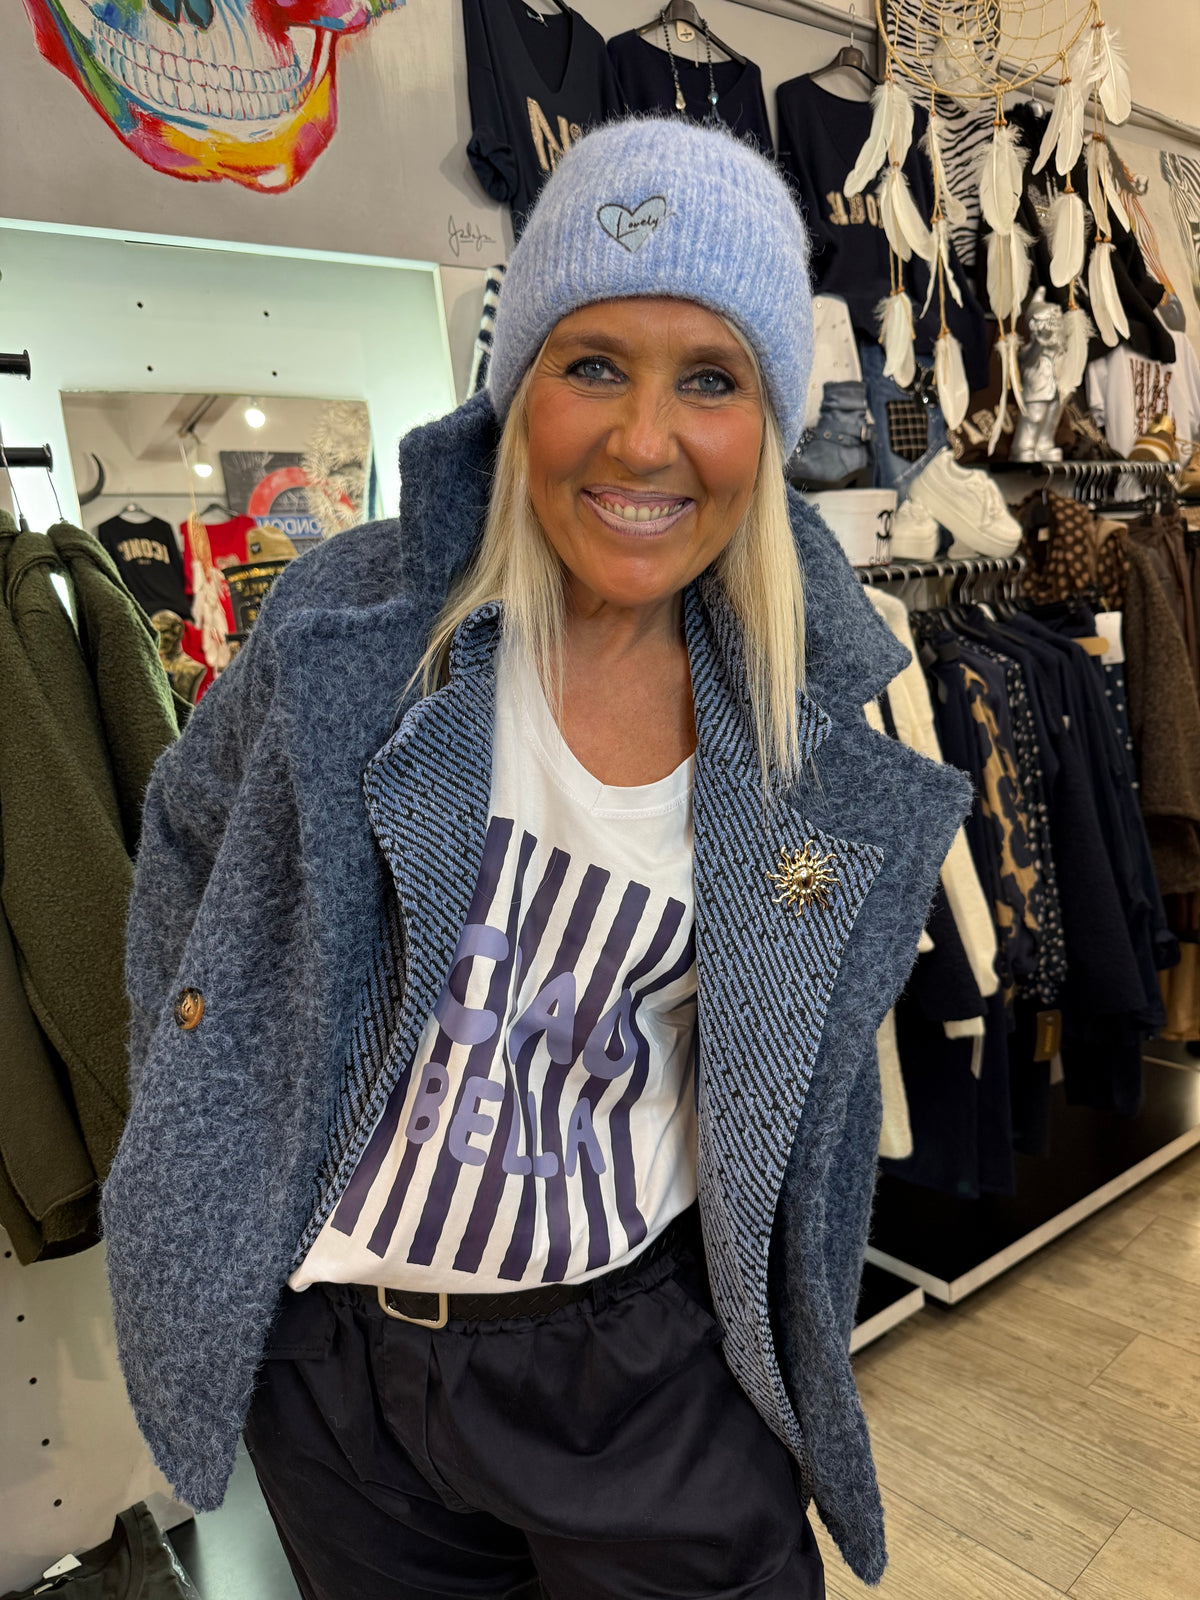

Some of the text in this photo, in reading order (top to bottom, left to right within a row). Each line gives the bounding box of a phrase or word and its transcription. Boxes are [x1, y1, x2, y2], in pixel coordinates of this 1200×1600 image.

[616, 211, 659, 239] Lovely
[433, 924, 639, 1080] CAO
[405, 1062, 607, 1178] BELLA
